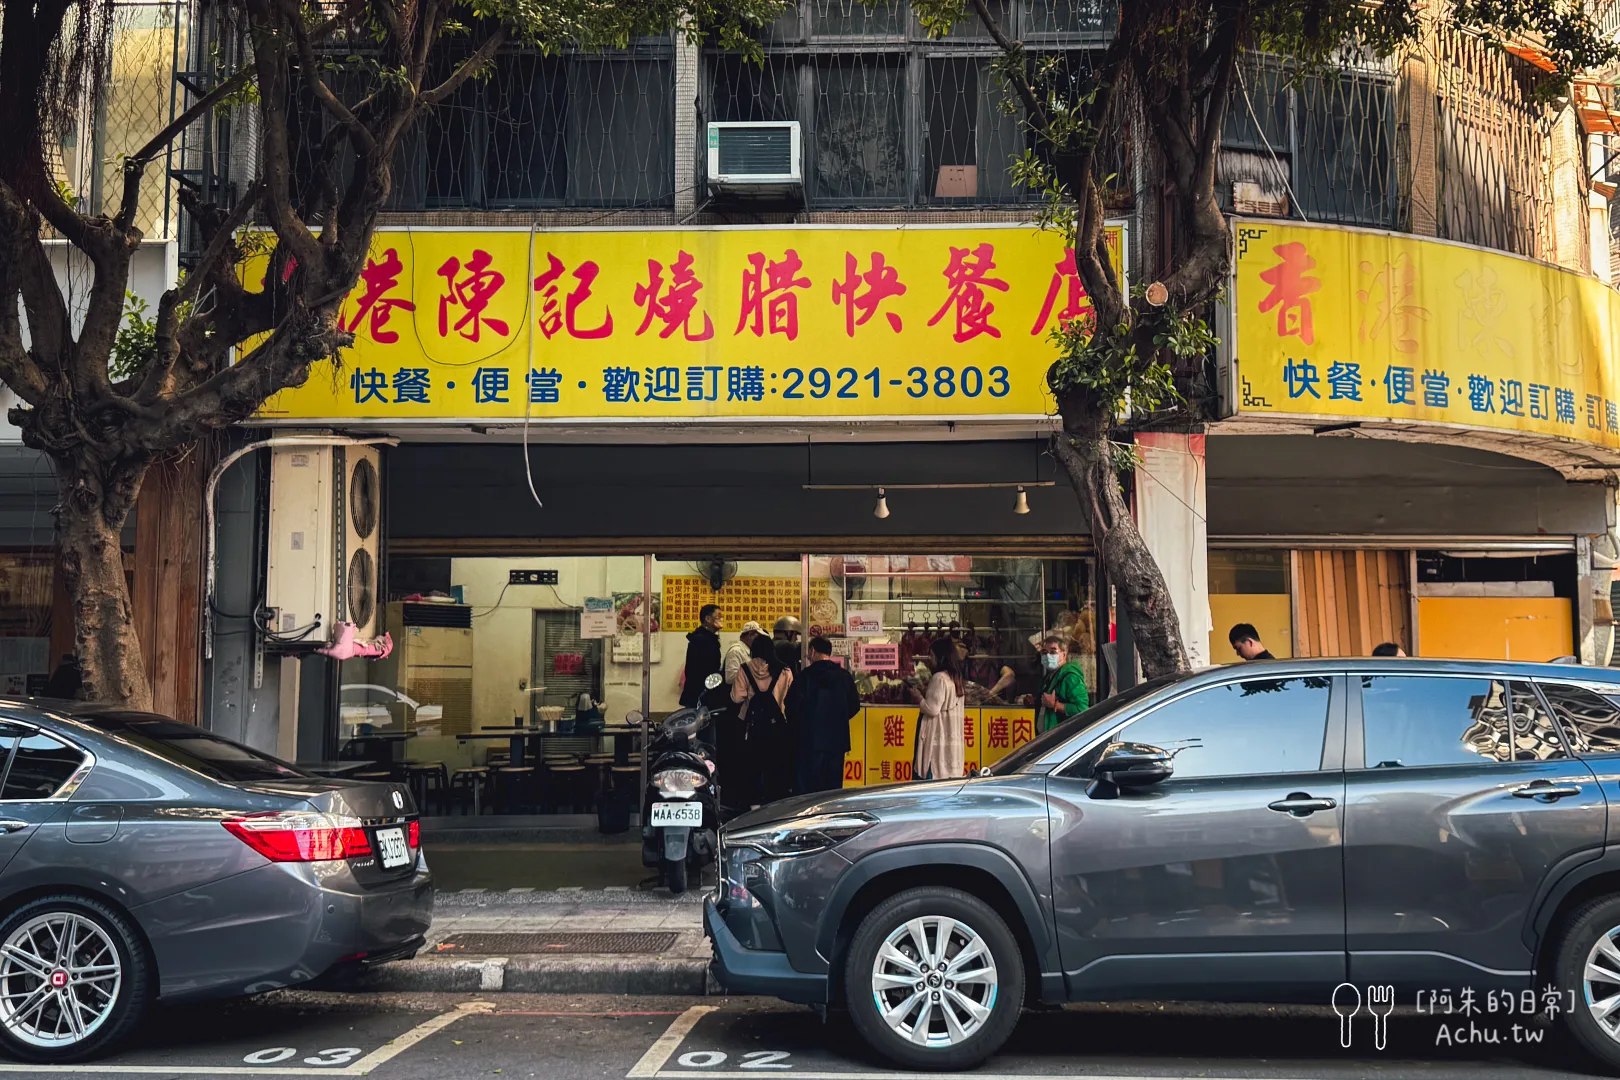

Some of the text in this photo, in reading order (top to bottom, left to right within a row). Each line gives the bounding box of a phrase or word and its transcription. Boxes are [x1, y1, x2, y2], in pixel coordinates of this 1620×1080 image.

[260, 243, 1097, 343] 港陳記燒腊快餐店
[884, 714, 905, 748] 雞
[987, 715, 1033, 749] 燒肉
[242, 1046, 362, 1066] 03
[677, 1050, 793, 1069] 02
